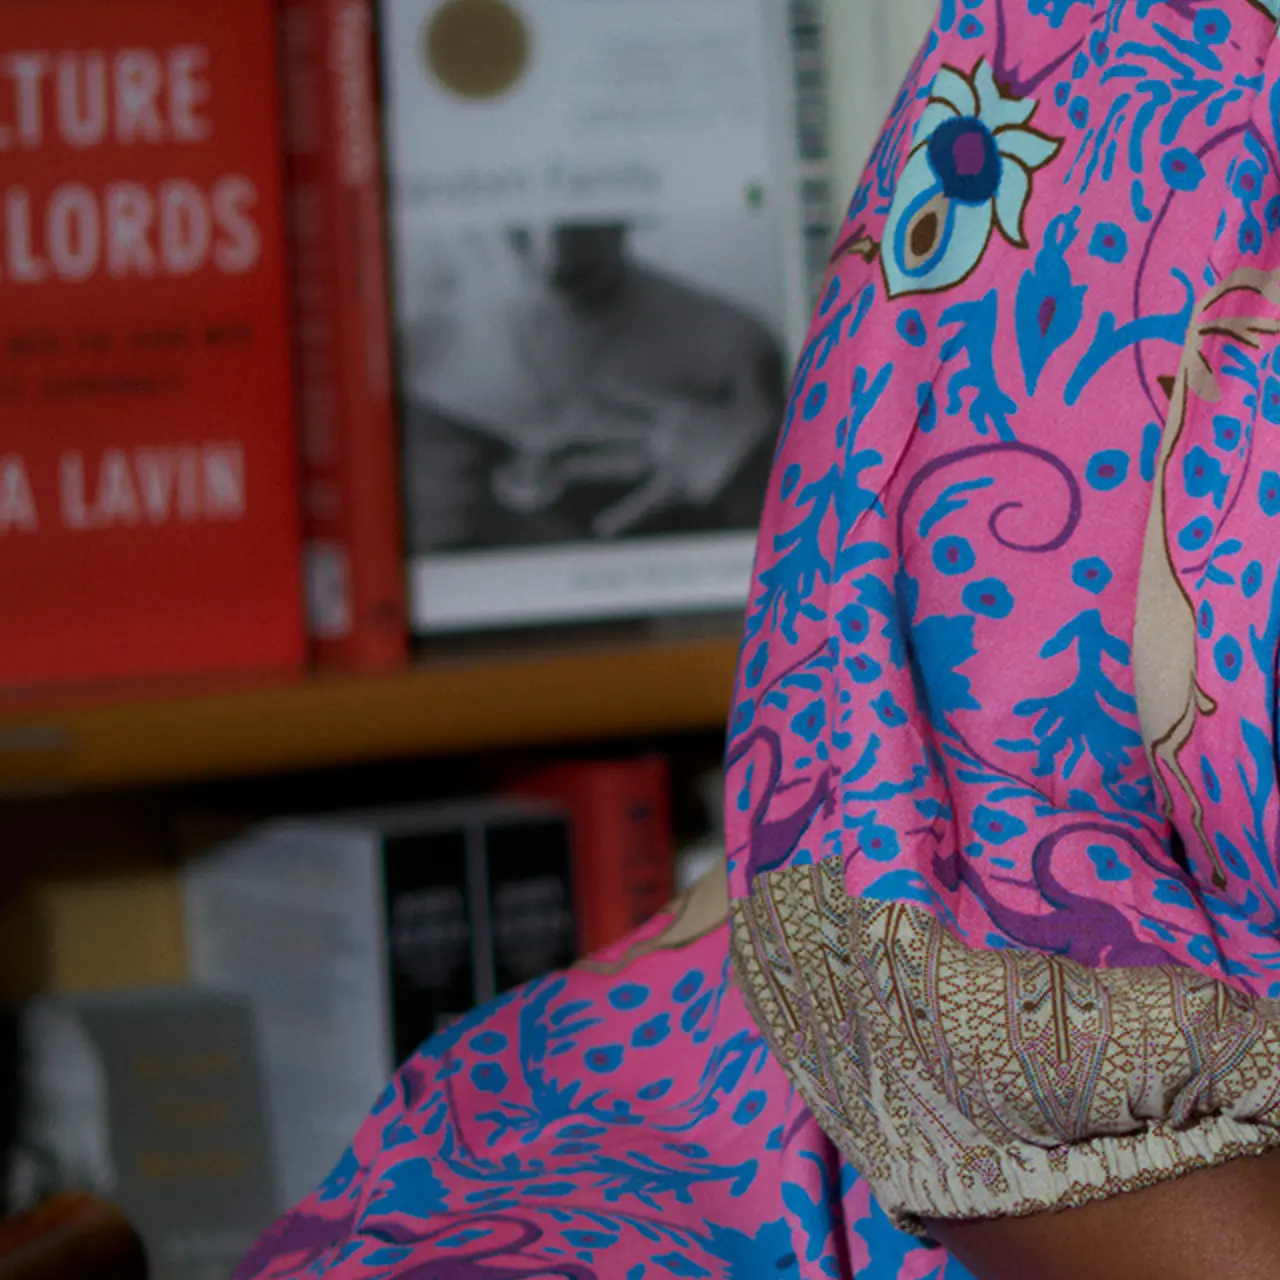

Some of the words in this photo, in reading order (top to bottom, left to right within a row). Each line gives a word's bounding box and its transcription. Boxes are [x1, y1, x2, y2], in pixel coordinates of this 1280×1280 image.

[0, 42, 213, 150] TURE
[3, 171, 262, 284] LORDS
[60, 443, 245, 530] LAVIN
